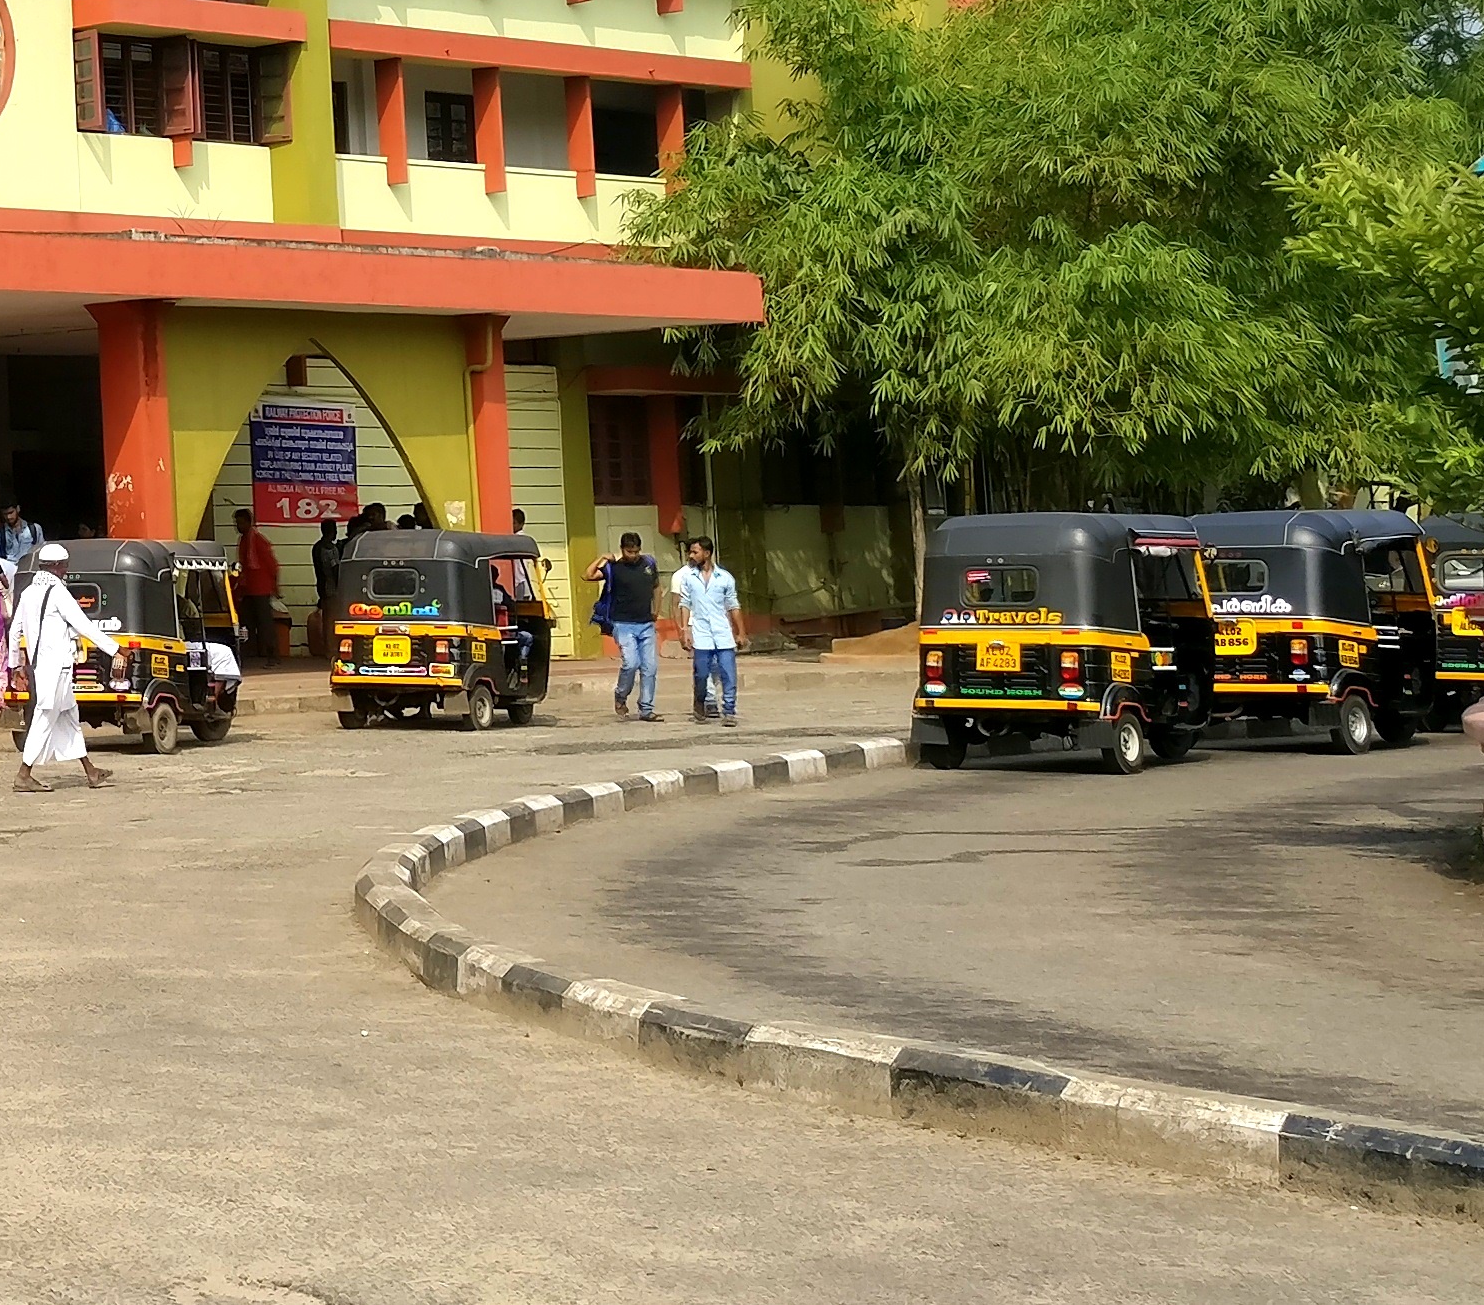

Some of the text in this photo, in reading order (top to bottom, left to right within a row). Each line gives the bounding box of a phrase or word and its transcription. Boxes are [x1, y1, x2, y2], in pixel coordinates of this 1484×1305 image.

[276, 497, 342, 519] 182
[976, 607, 1063, 625] Travels
[1228, 638, 1249, 647] 856
